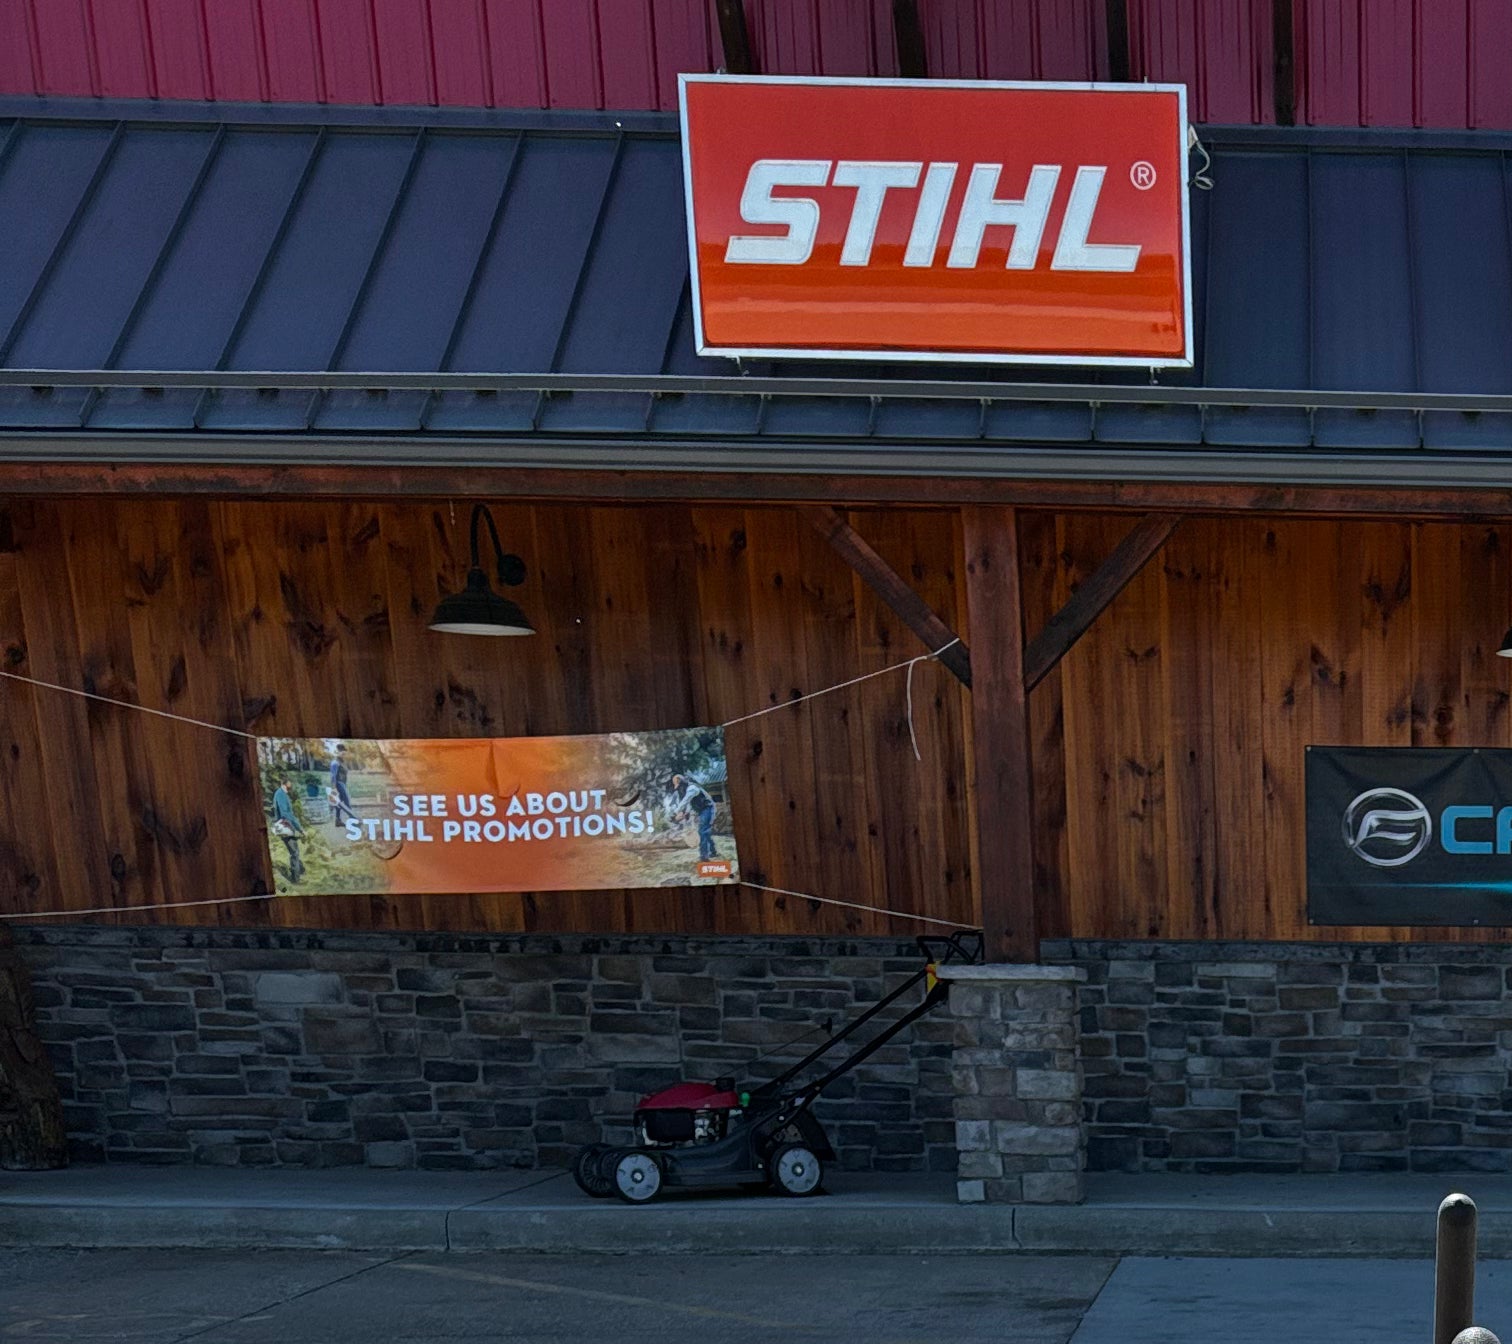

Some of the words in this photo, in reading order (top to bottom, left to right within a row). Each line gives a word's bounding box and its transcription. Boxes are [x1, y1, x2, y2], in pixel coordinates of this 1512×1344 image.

[393, 794, 446, 818] SEE
[458, 793, 496, 816] US
[507, 789, 606, 816] ABOUT
[345, 817, 433, 843] STIHL
[443, 811, 655, 843] PROMOTIONS!
